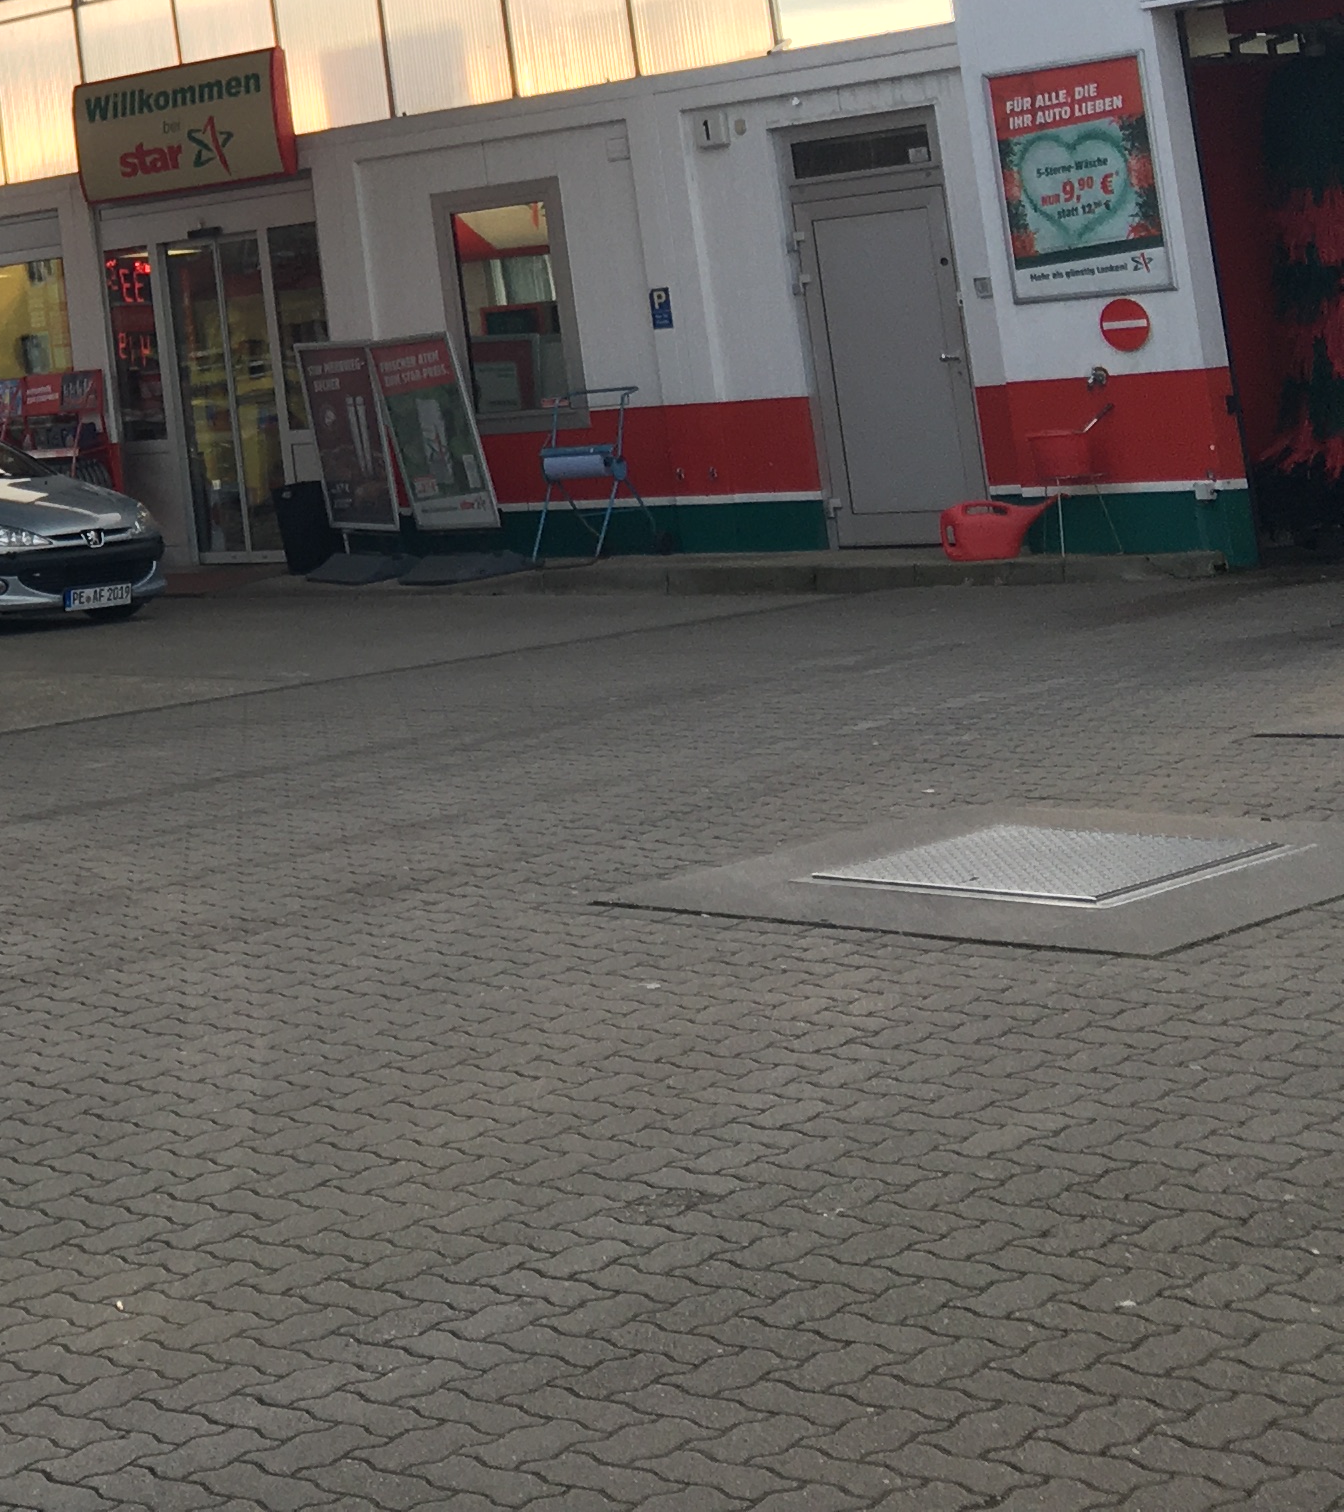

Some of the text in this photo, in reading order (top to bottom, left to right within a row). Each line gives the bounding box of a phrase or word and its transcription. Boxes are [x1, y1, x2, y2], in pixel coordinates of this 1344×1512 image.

[85, 72, 261, 123] Willkommen
[1006, 83, 1097, 114] FÜR ALLE, DIE
[1009, 95, 1123, 130] IHR AUTO LIEBEN
[163, 120, 181, 134] bei
[119, 142, 182, 178] star
[653, 291, 666, 309] P
